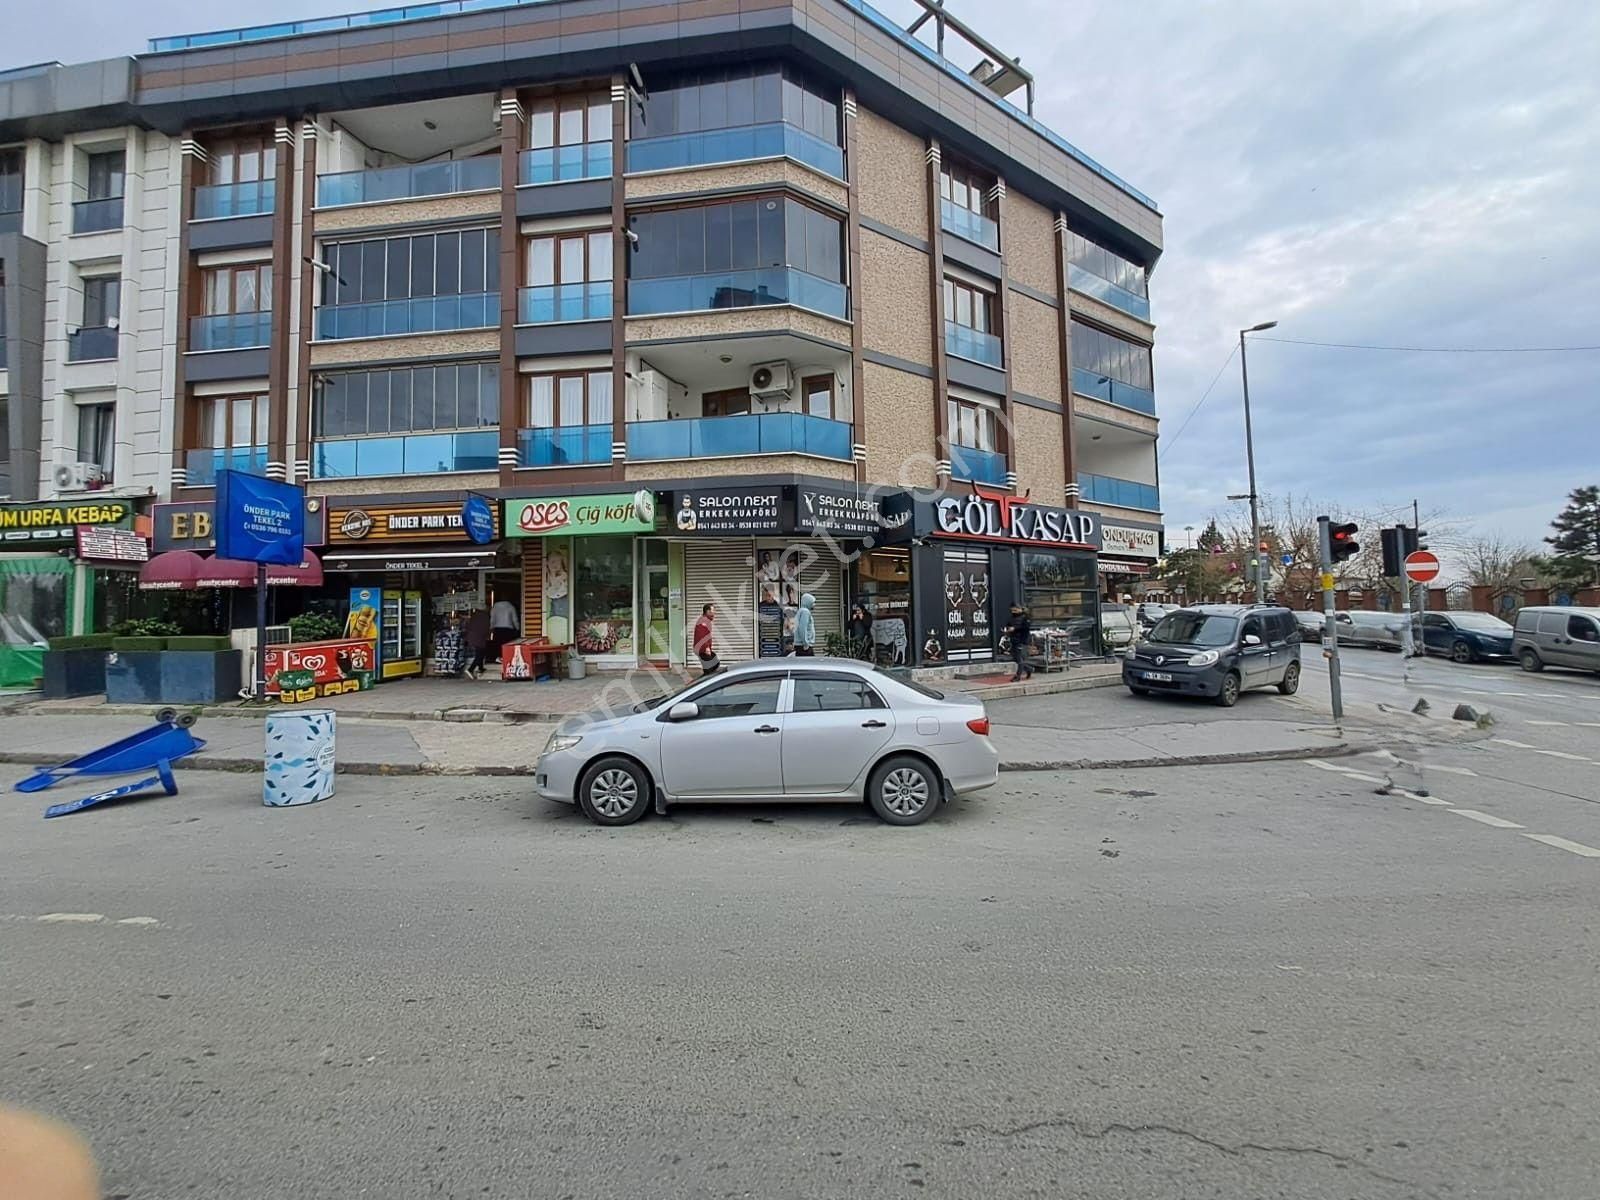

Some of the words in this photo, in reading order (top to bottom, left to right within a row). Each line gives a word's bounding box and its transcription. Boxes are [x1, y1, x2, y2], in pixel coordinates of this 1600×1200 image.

[699, 496, 741, 507] SALON
[743, 495, 778, 507] NEXT
[818, 495, 853, 509] SALON
[854, 500, 880, 511] NEXT
[20, 508, 63, 526] URFA
[67, 505, 124, 523] KEBAP
[243, 503, 270, 516] ÖNDER
[270, 510, 291, 520] PARK
[576, 504, 600, 524] Çiğ
[605, 502, 637, 524] köft
[699, 509, 730, 518] ERKEK
[732, 507, 777, 517] KUAFÖRÜ
[819, 508, 844, 518] ERKEK
[253, 515, 277, 526] TEKEL
[389, 514, 419, 529] ÖNDER
[421, 515, 446, 528] PARK
[935, 494, 1002, 536] GÖL
[1009, 505, 1094, 544] KASAP
[385, 561, 405, 569] ÖNDER
[948, 609, 964, 624] GÖL
[973, 609, 988, 623] GÖL
[947, 627, 966, 638] KASAP
[972, 627, 990, 637] KASAP
